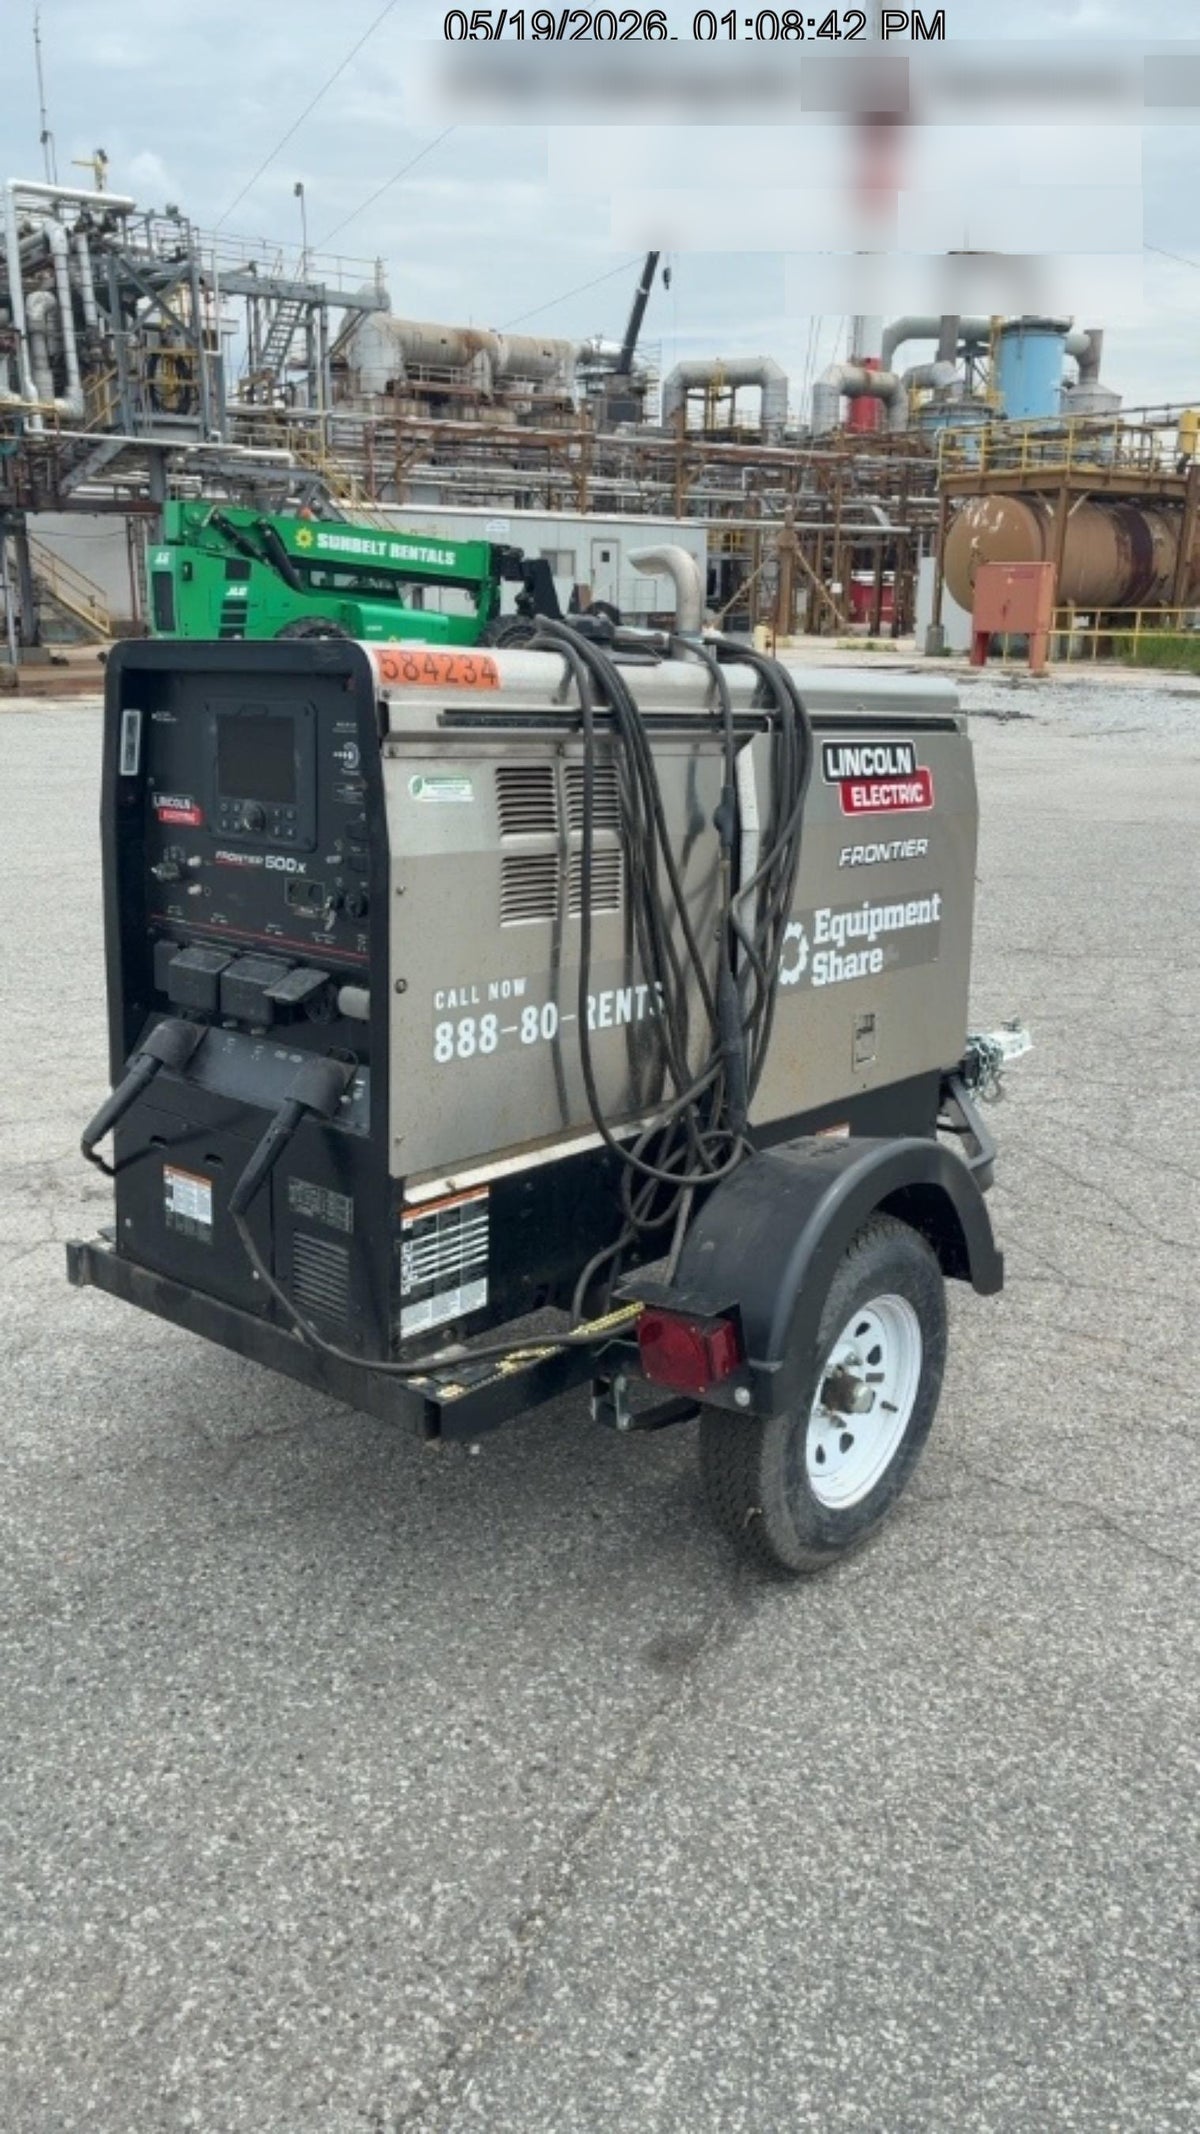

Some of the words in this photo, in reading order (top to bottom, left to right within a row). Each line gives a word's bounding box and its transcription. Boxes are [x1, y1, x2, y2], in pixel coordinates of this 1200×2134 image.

[389, 542, 456, 565] RENTALS
[380, 650, 497, 684] 584234
[827, 747, 911, 776] LINCOLN
[852, 783, 923, 807] ELECTRIC
[839, 838, 930, 867] FRONTIER
[814, 893, 942, 942] Equipment
[811, 948, 883, 987] Share
[434, 991, 480, 1010] CALL
[488, 977, 528, 1000] NOW
